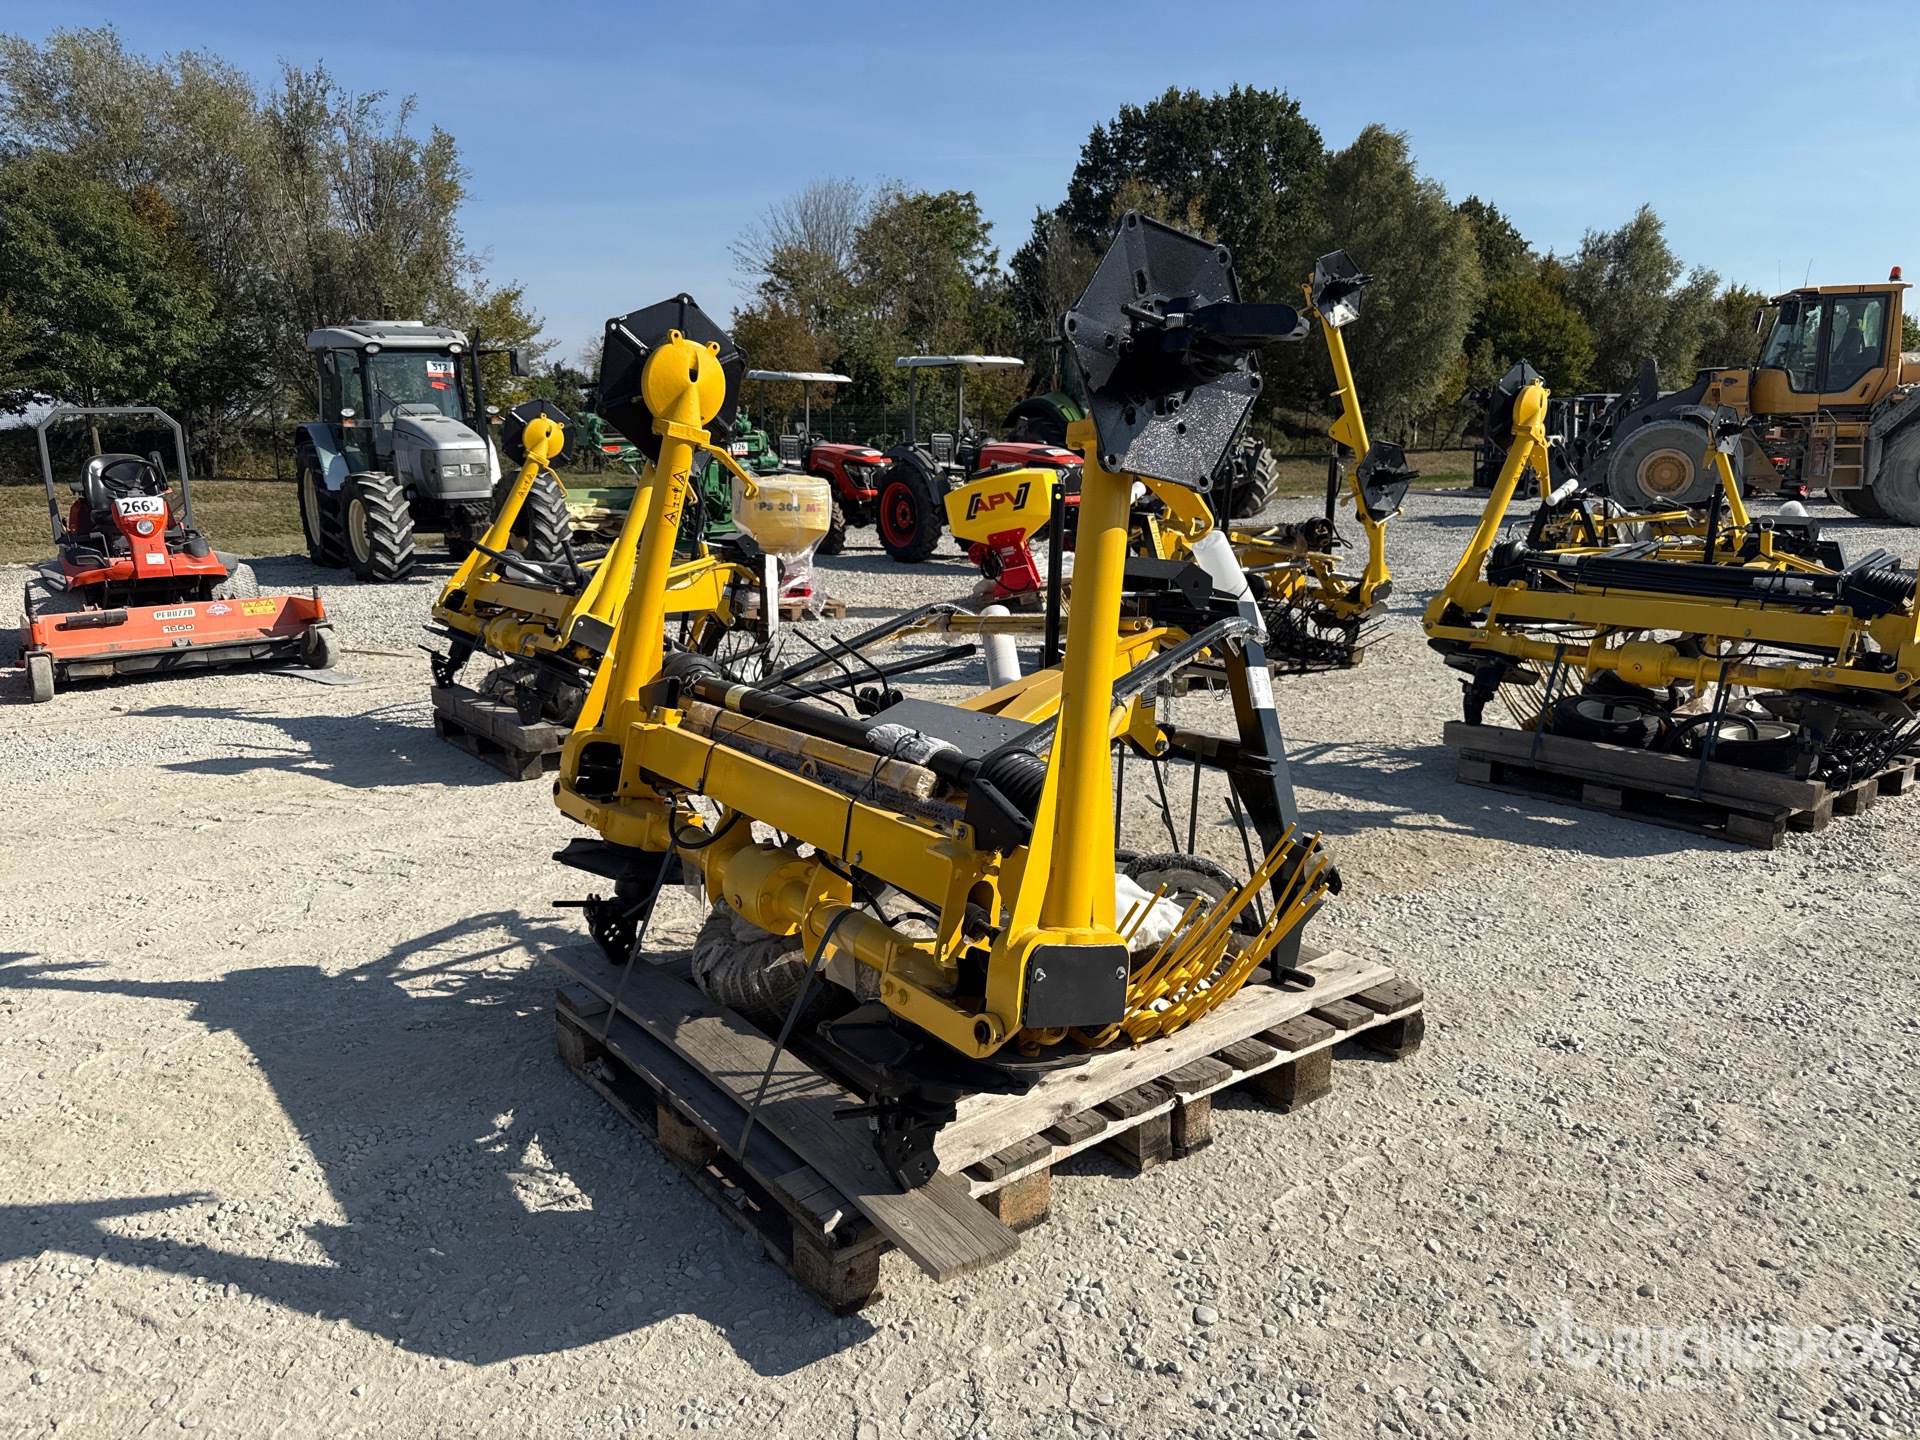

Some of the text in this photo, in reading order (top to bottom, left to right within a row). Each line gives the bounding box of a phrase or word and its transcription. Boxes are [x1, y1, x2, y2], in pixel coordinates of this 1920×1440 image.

[432, 363, 448, 371] 513
[759, 501, 774, 511] PS
[973, 488, 1022, 515] APV
[156, 608, 193, 619] PERUZZO
[164, 624, 194, 632] 1600
